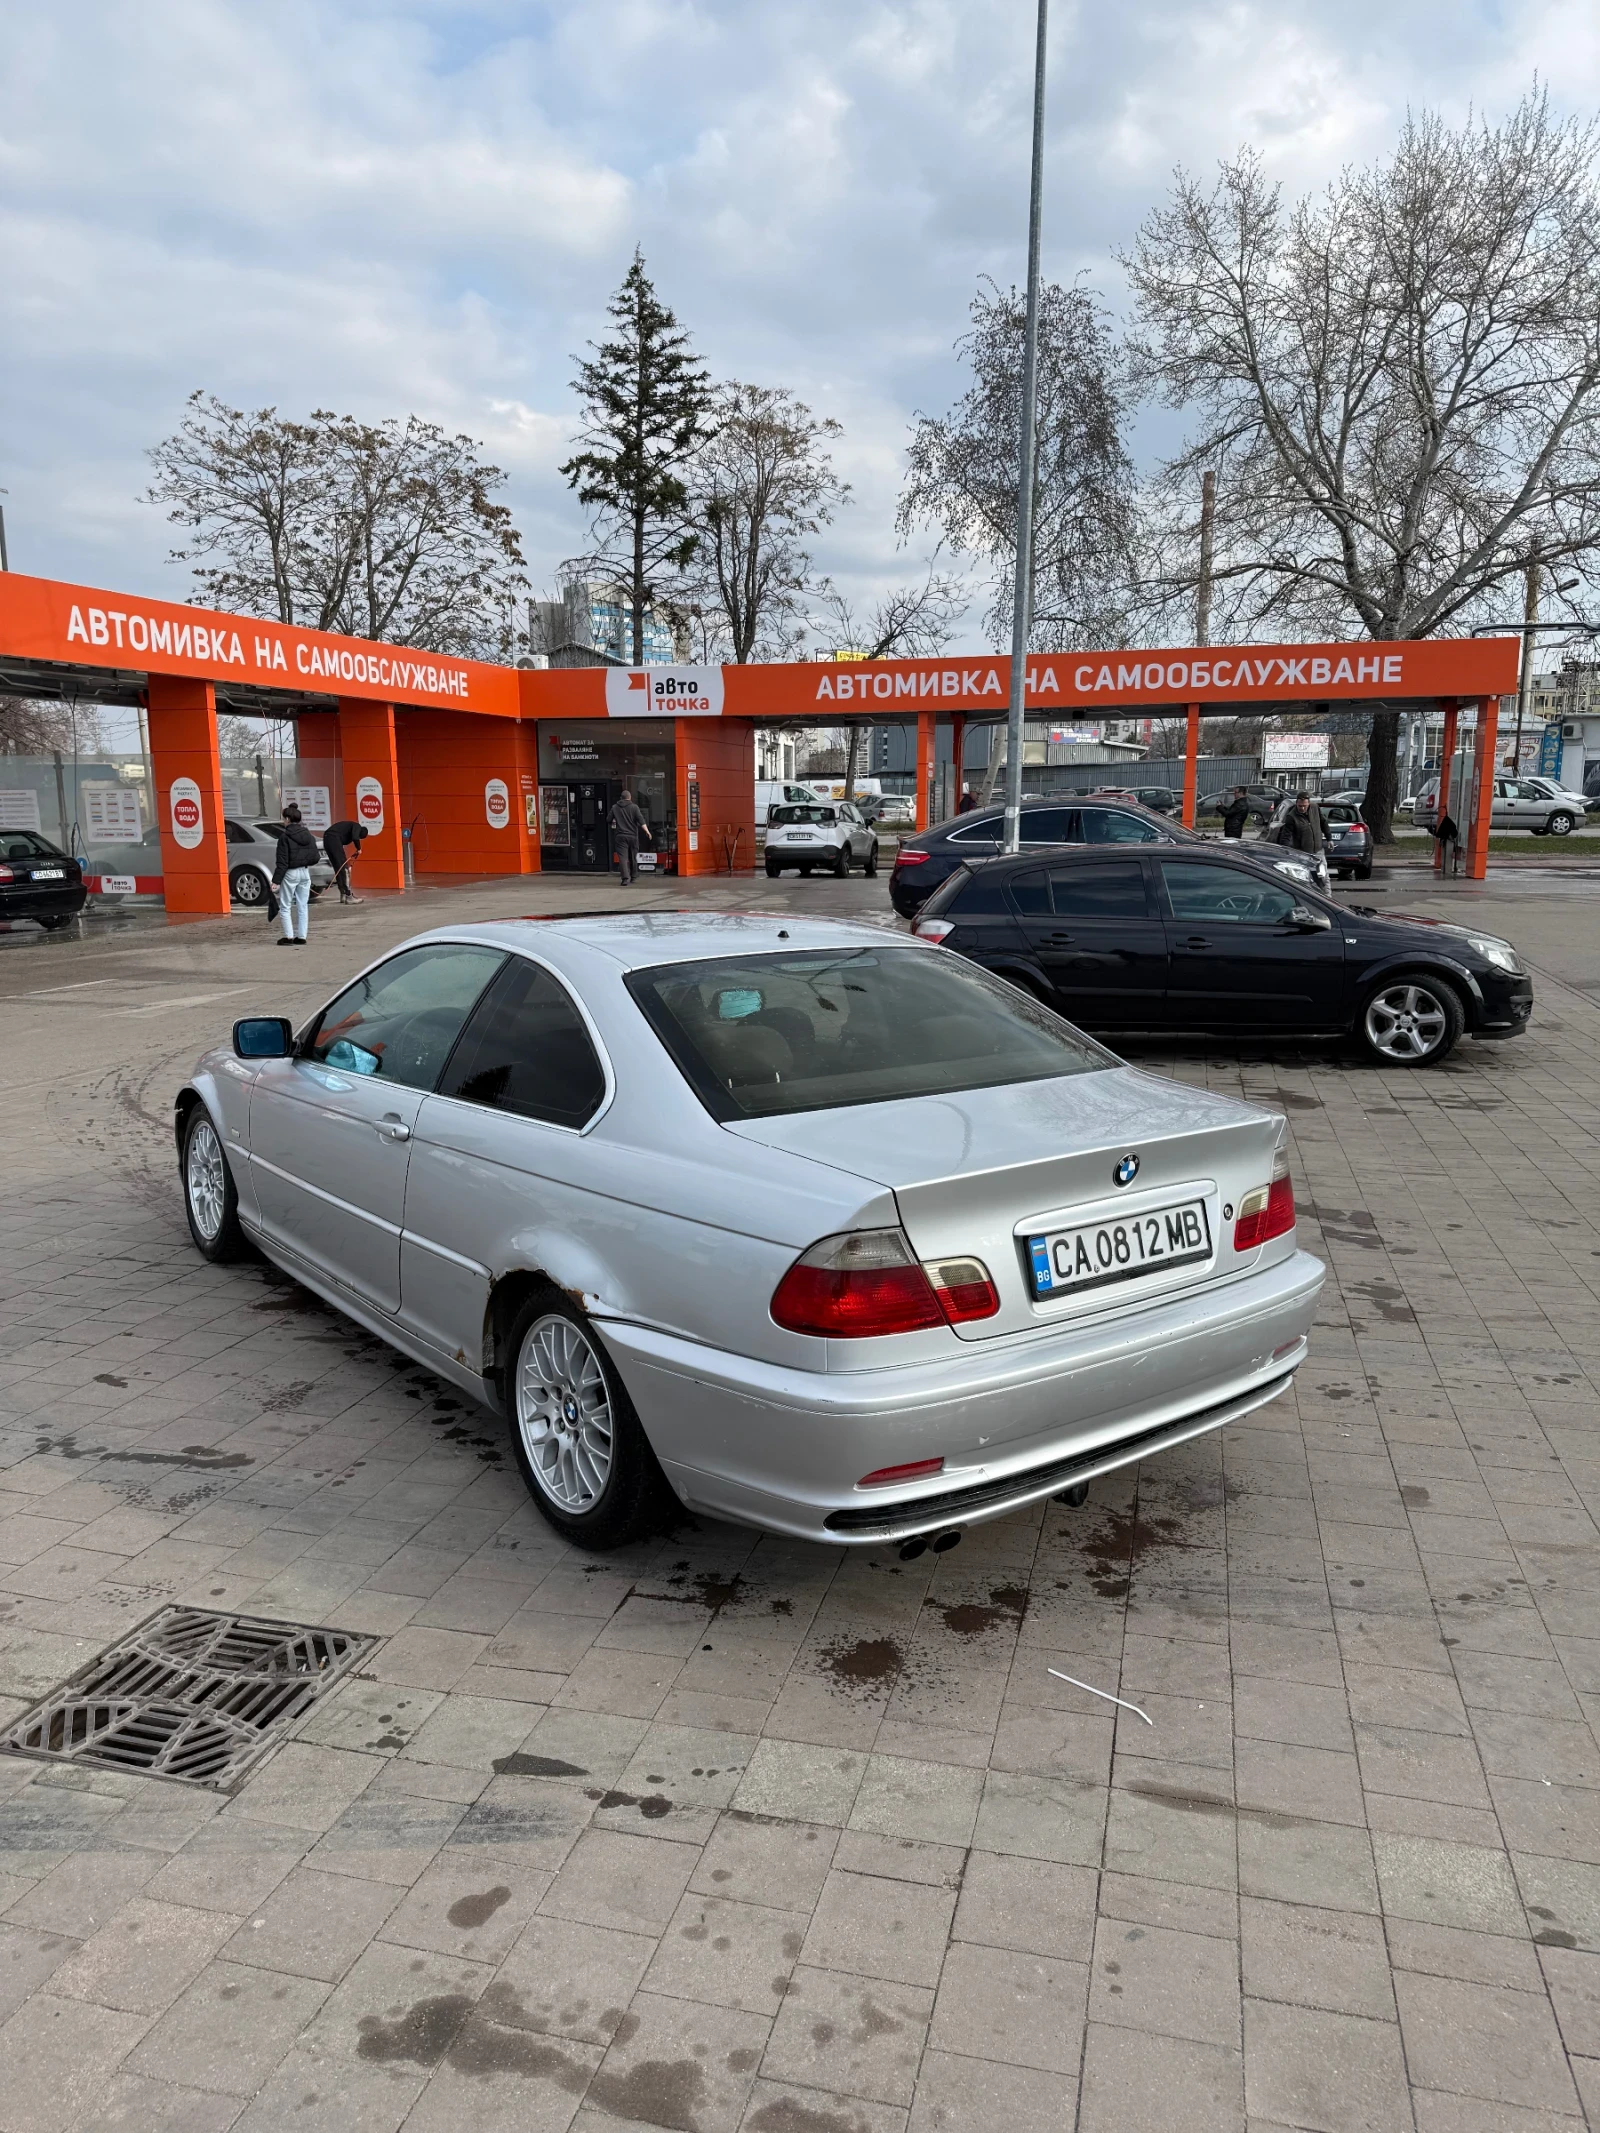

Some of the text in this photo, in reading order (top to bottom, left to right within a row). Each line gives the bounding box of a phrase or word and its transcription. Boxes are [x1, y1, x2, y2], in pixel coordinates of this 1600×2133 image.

[67, 605, 469, 698] АВТОМИВКА НА САМООБСЛУЖВАНЕ
[654, 677, 698, 694] авто
[815, 655, 1403, 700] АВТОМИВКА НА САМООБСЛУЖВАНЕ
[655, 697, 710, 711] точка
[1036, 1270, 1050, 1284] BG
